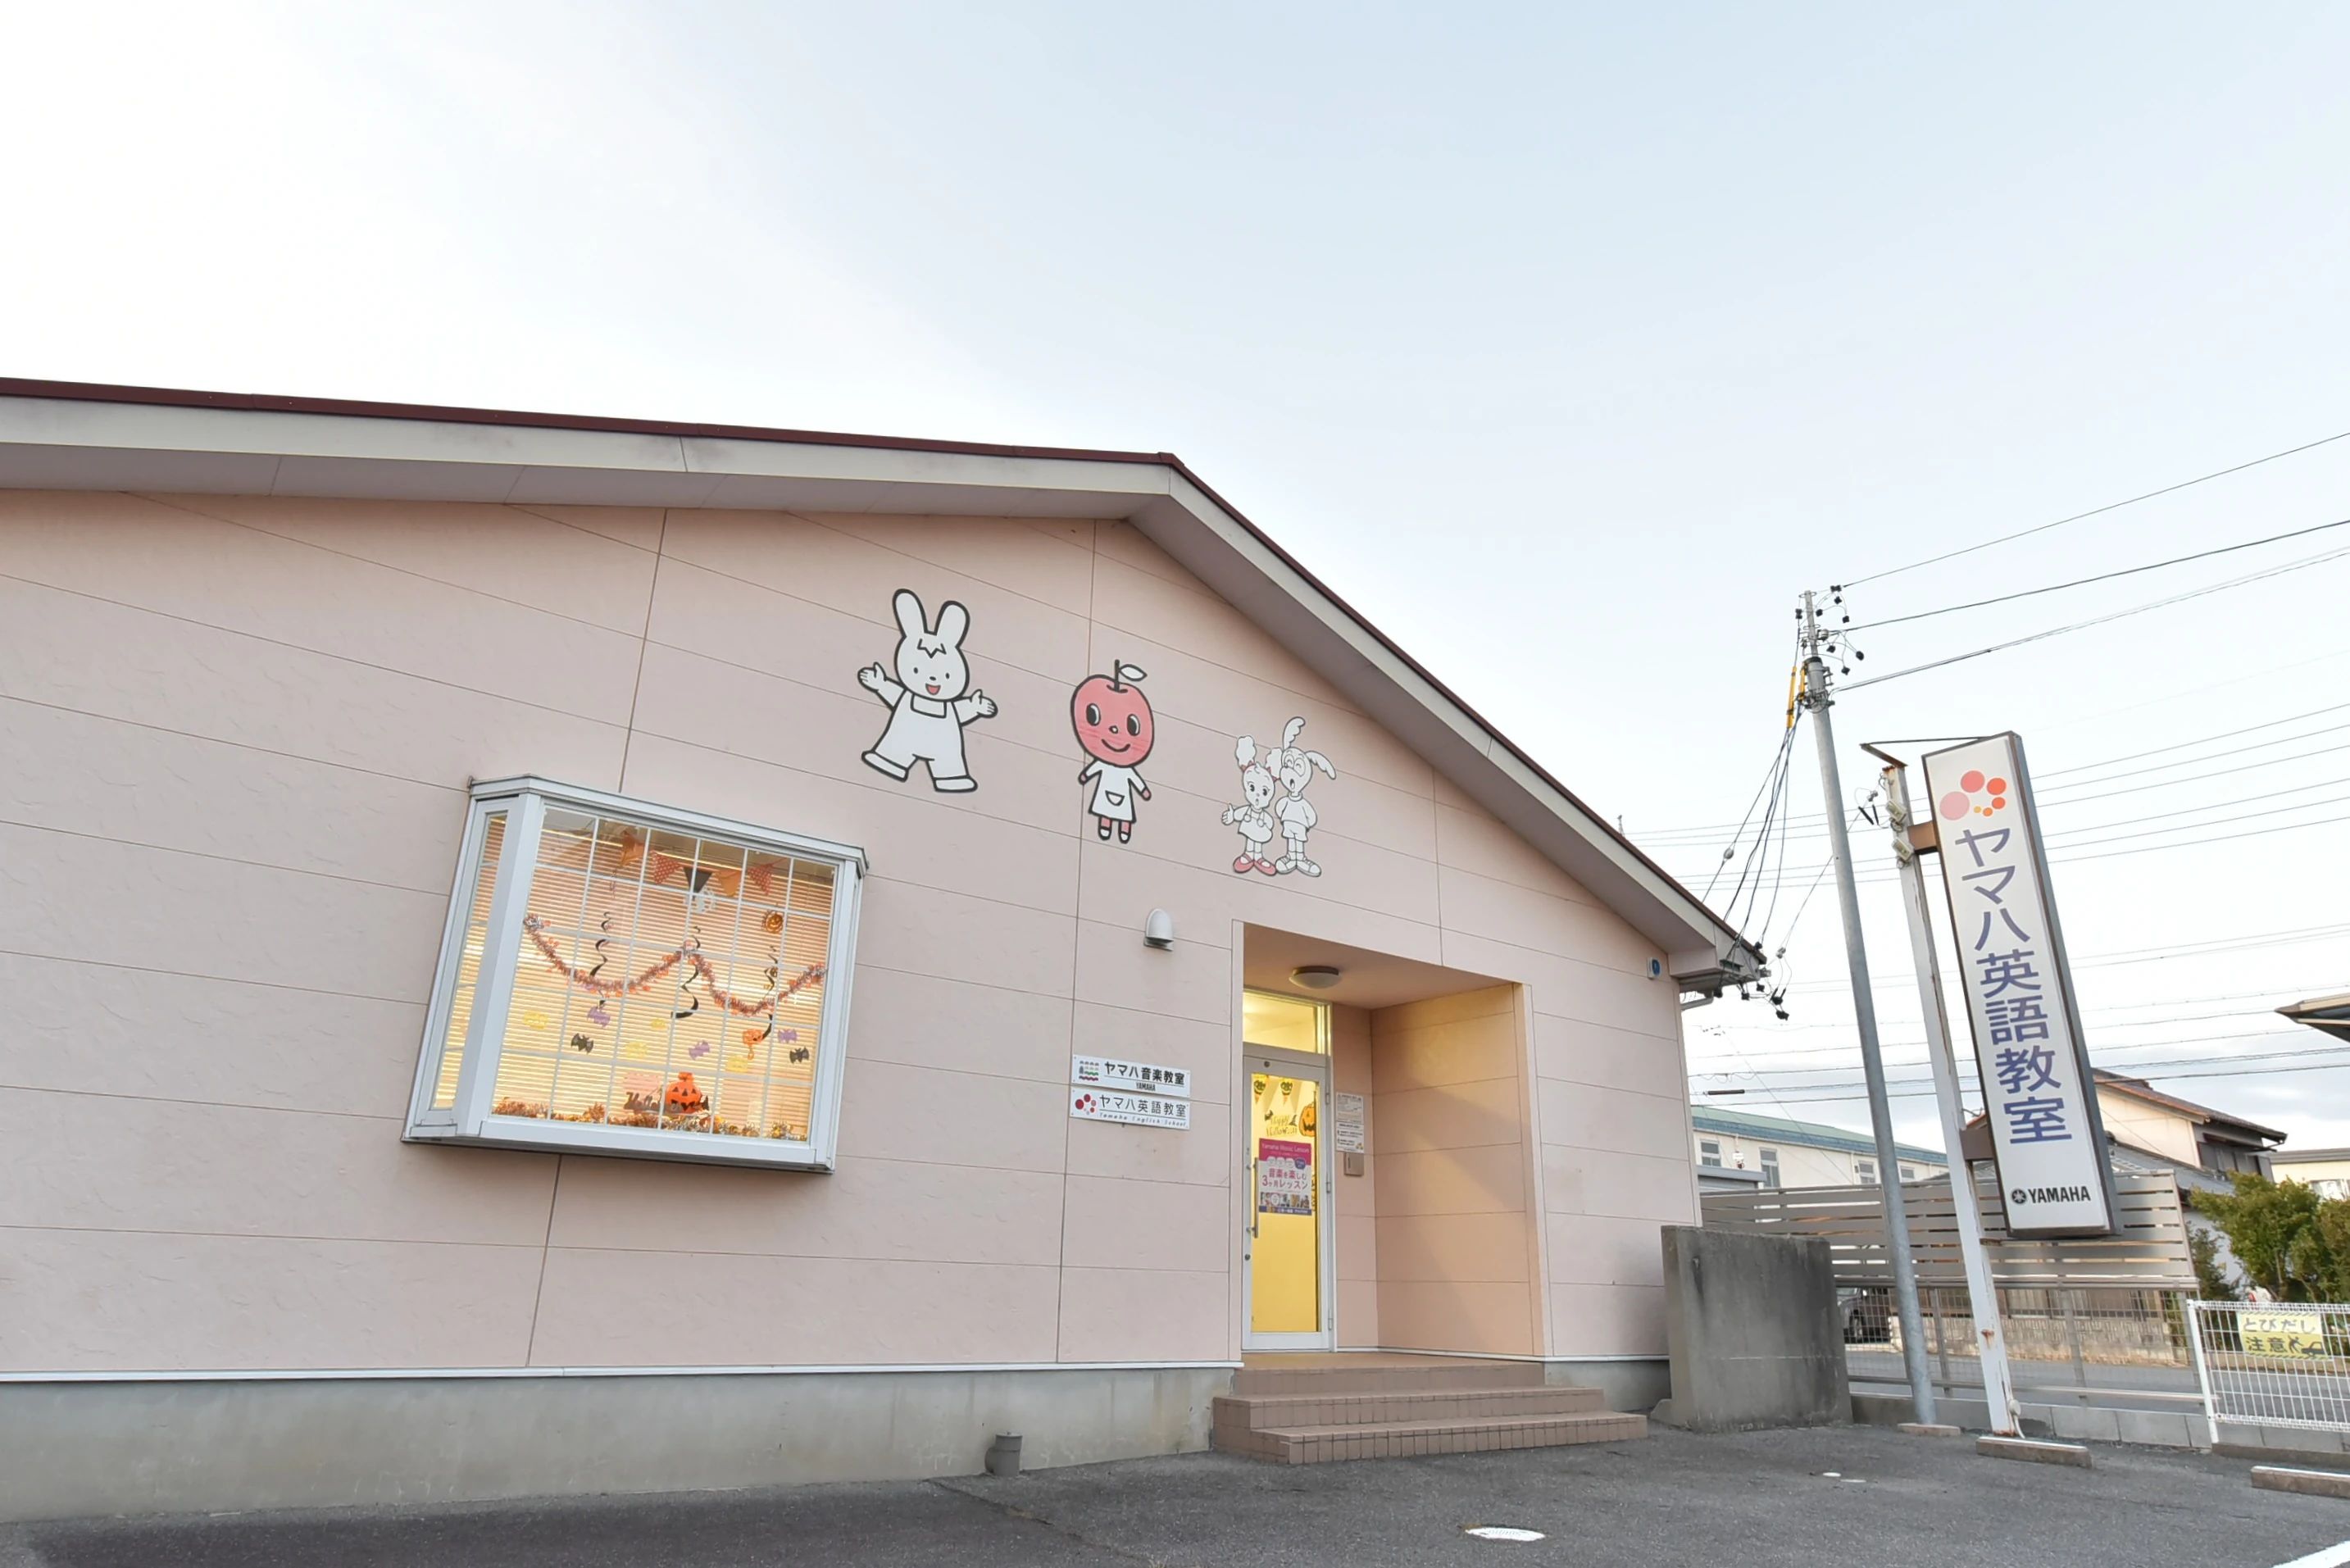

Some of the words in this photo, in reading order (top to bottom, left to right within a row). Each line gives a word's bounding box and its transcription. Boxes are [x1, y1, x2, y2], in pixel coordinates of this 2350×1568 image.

[1955, 827, 2072, 1144] ヤマハ英語教室
[1105, 1061, 1184, 1085] ヤマハ音楽教室
[1136, 1082, 1156, 1092] YAMAHA
[1099, 1095, 1186, 1117] ヤマハ英語教室
[2028, 1185, 2091, 1204] YAMAHA
[2243, 1317, 2316, 1334] とびだし
[2245, 1336, 2288, 1353] 注意
